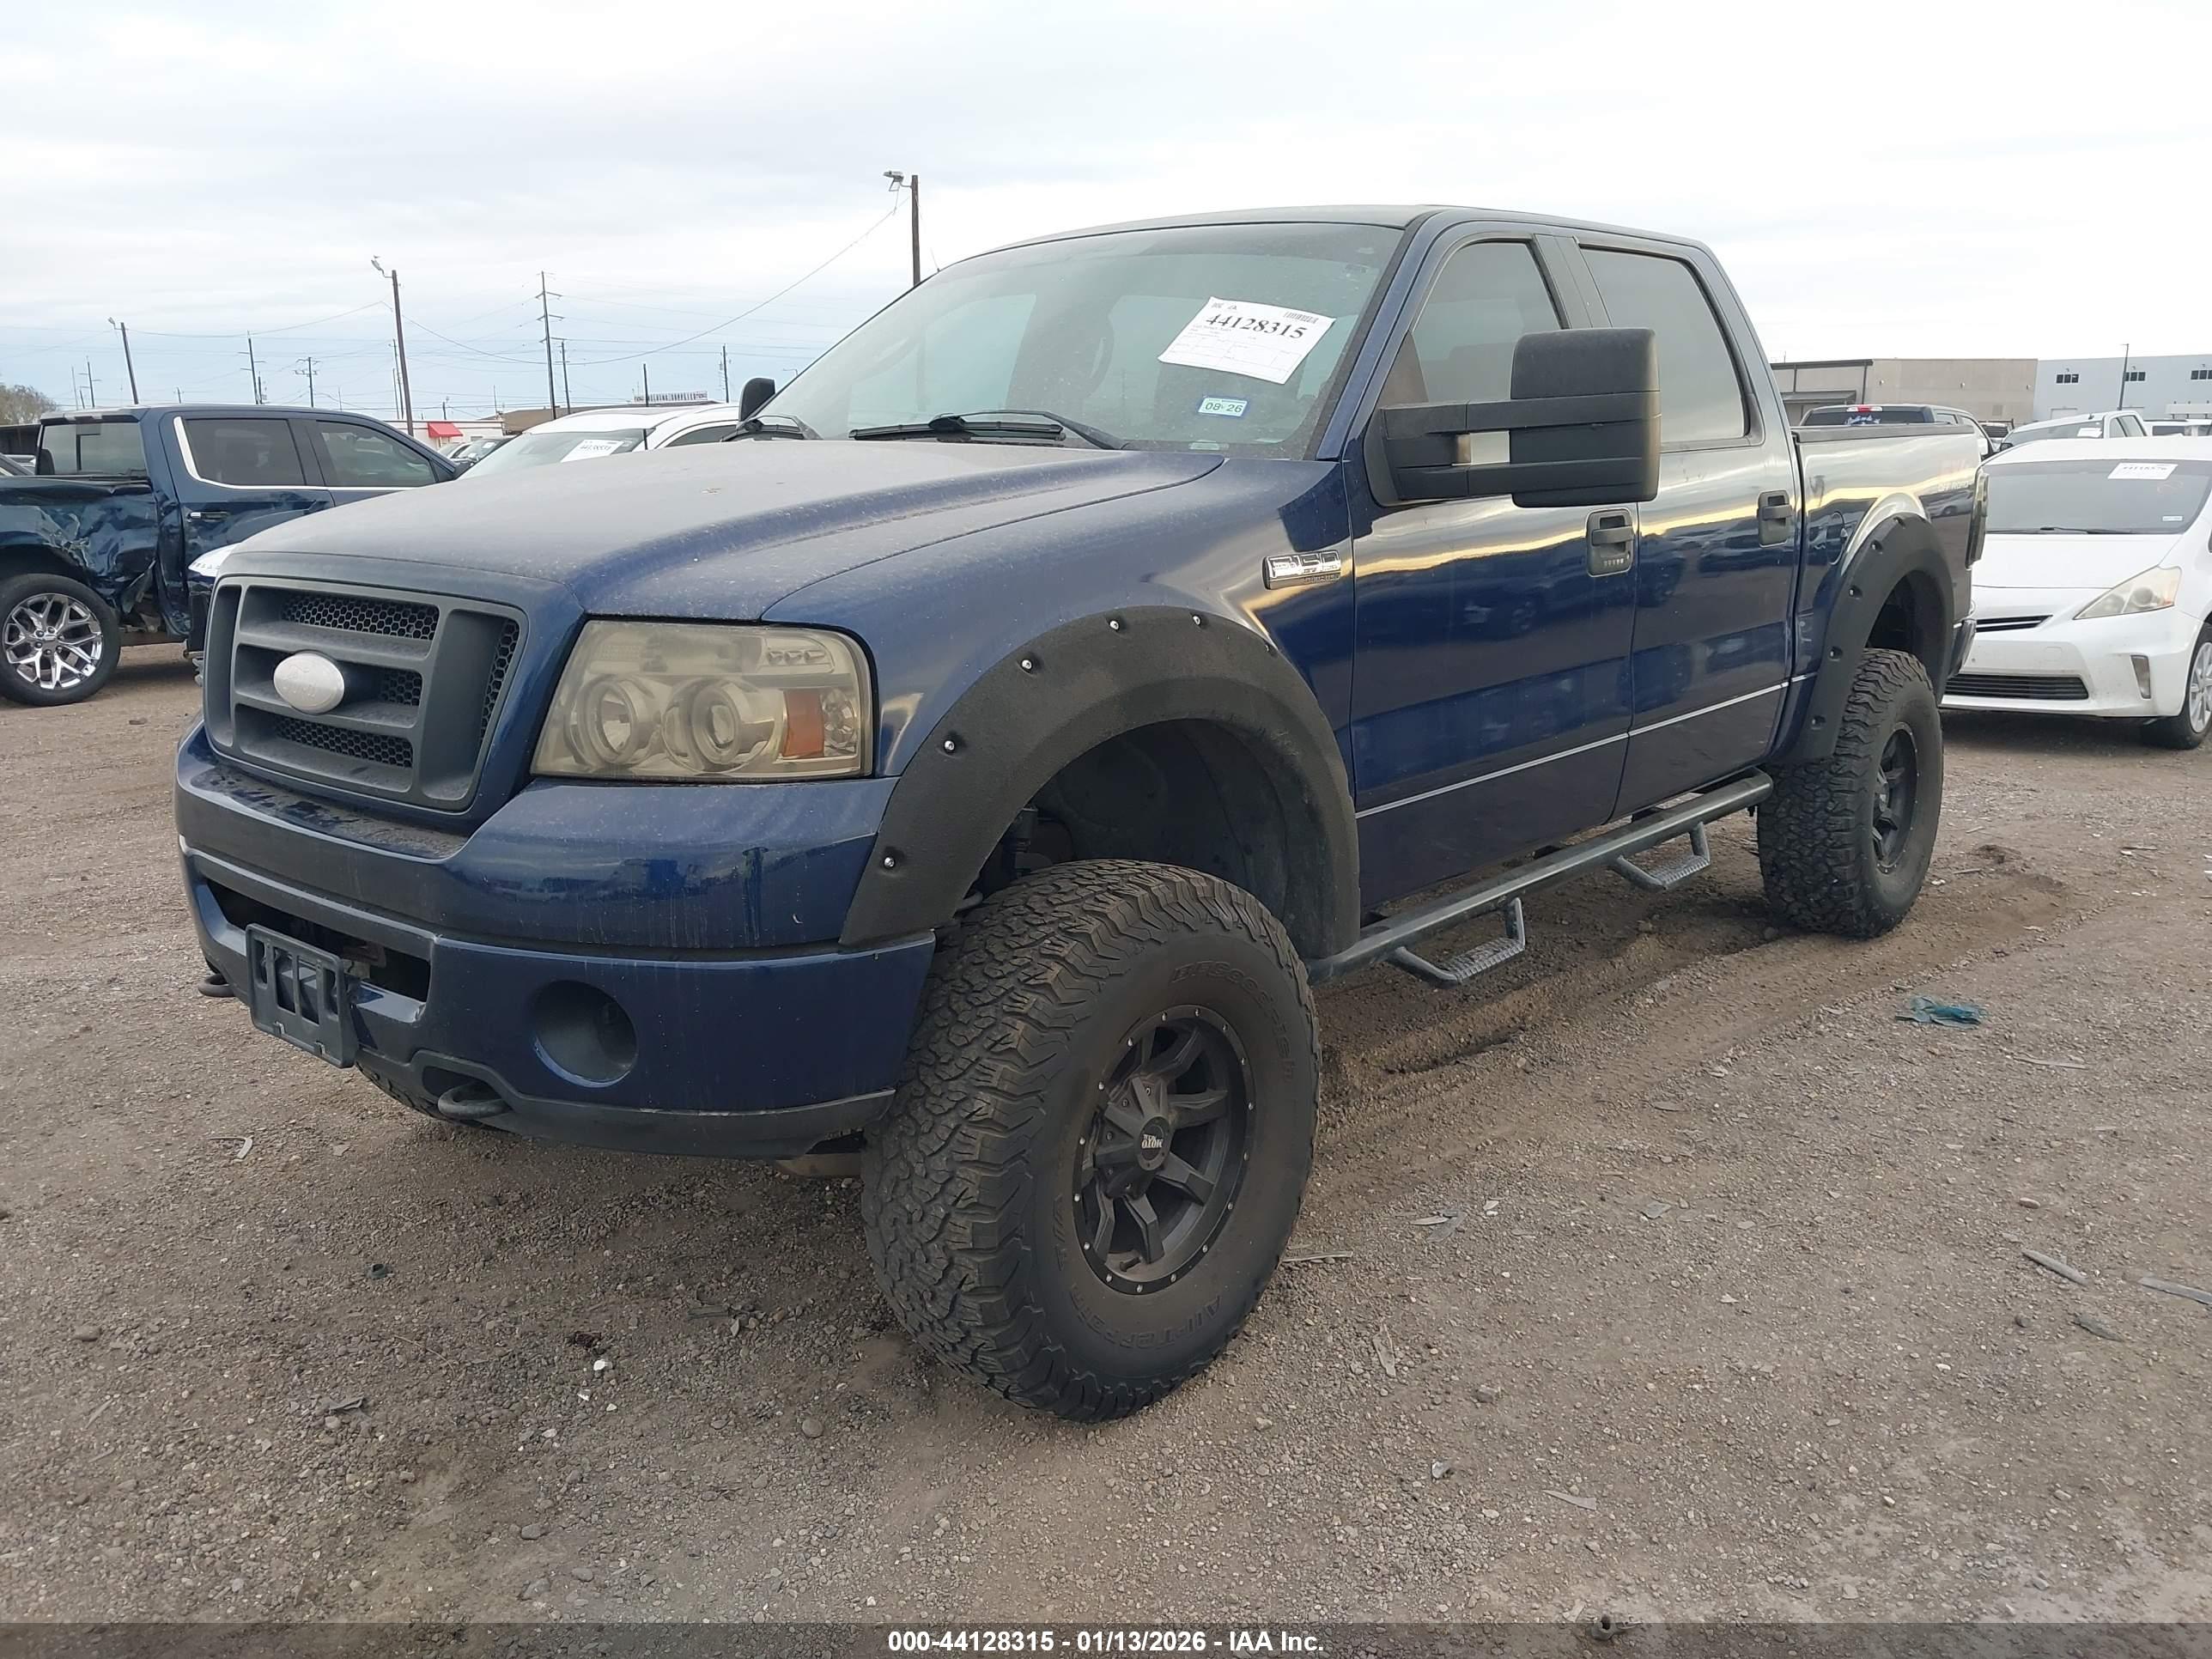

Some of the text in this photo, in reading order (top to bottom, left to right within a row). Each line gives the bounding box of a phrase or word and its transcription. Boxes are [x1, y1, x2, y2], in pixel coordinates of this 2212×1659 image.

[1206, 313, 1308, 339] 44128315
[1205, 402, 1243, 414] 08 26
[1141, 1139, 1164, 1149] MOTO
